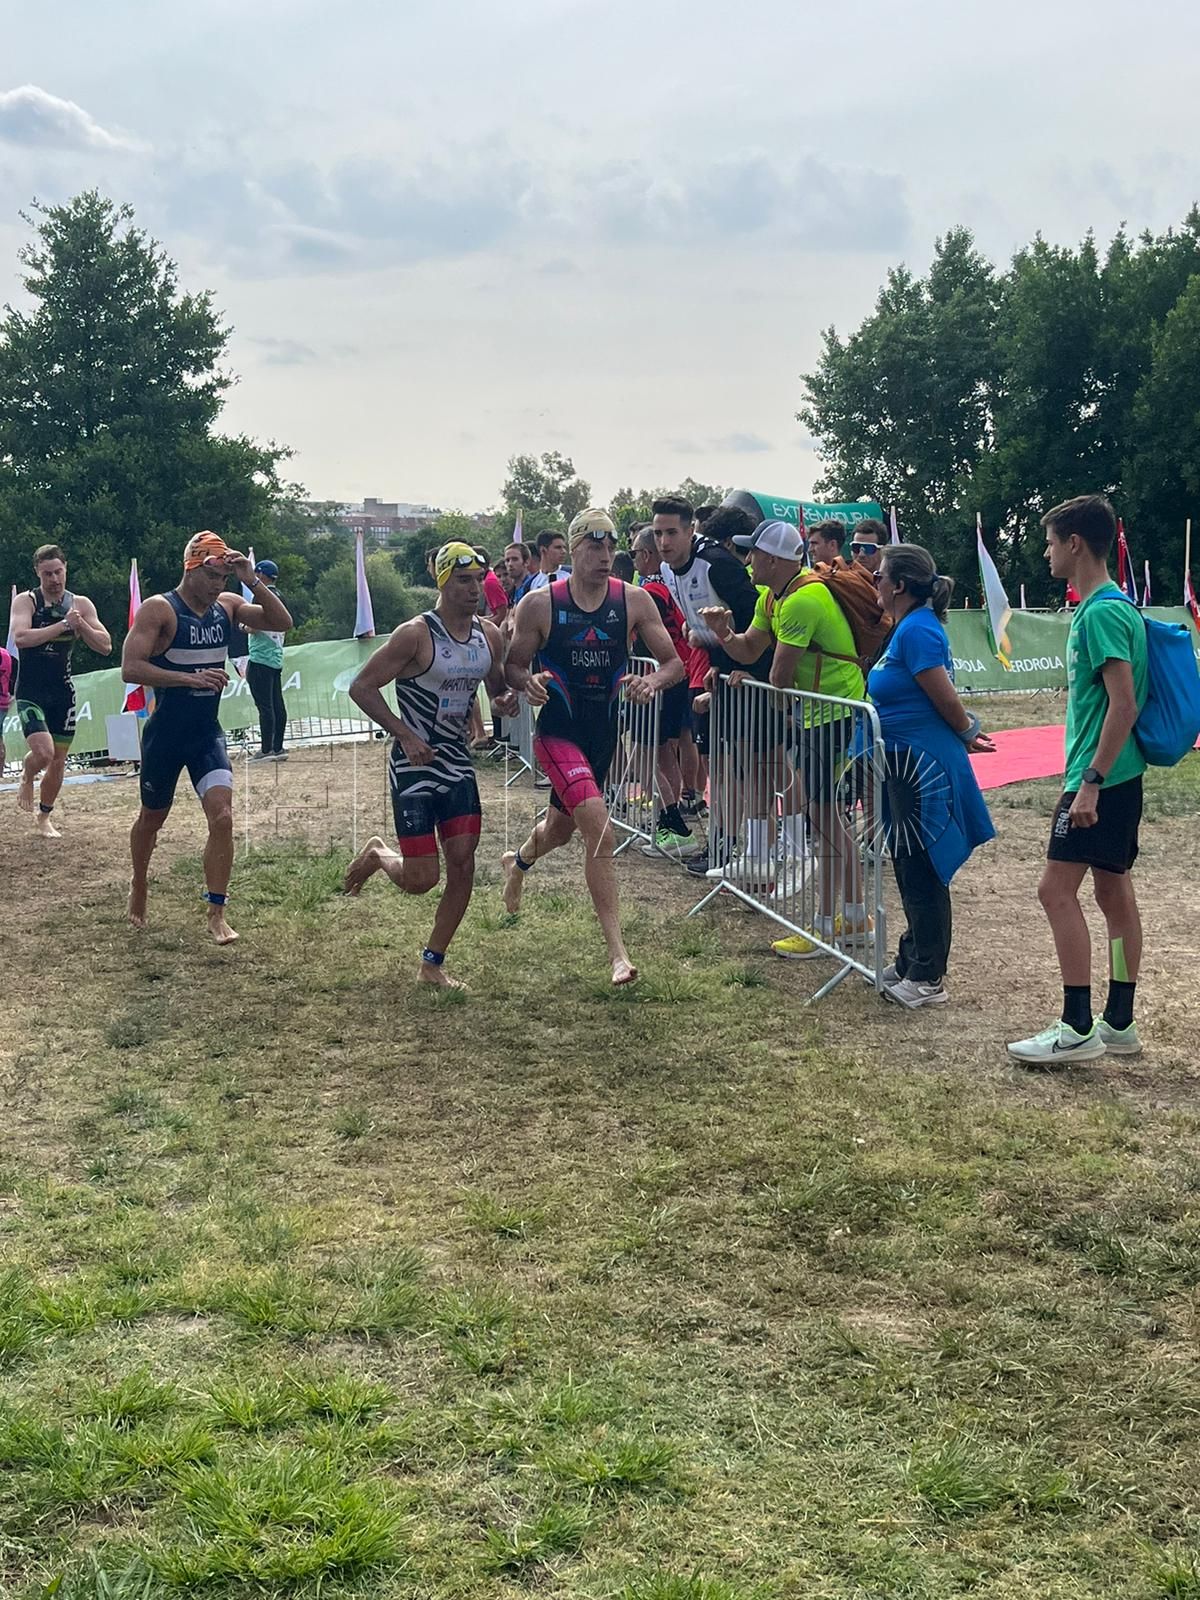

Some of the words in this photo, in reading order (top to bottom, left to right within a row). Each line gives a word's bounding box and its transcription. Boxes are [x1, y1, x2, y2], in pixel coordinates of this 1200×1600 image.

[772, 503, 871, 525] EXTREMADURA
[189, 623, 224, 645] BLANCO
[571, 650, 611, 668] BASANTA
[1002, 655, 1064, 673] IERDROLA
